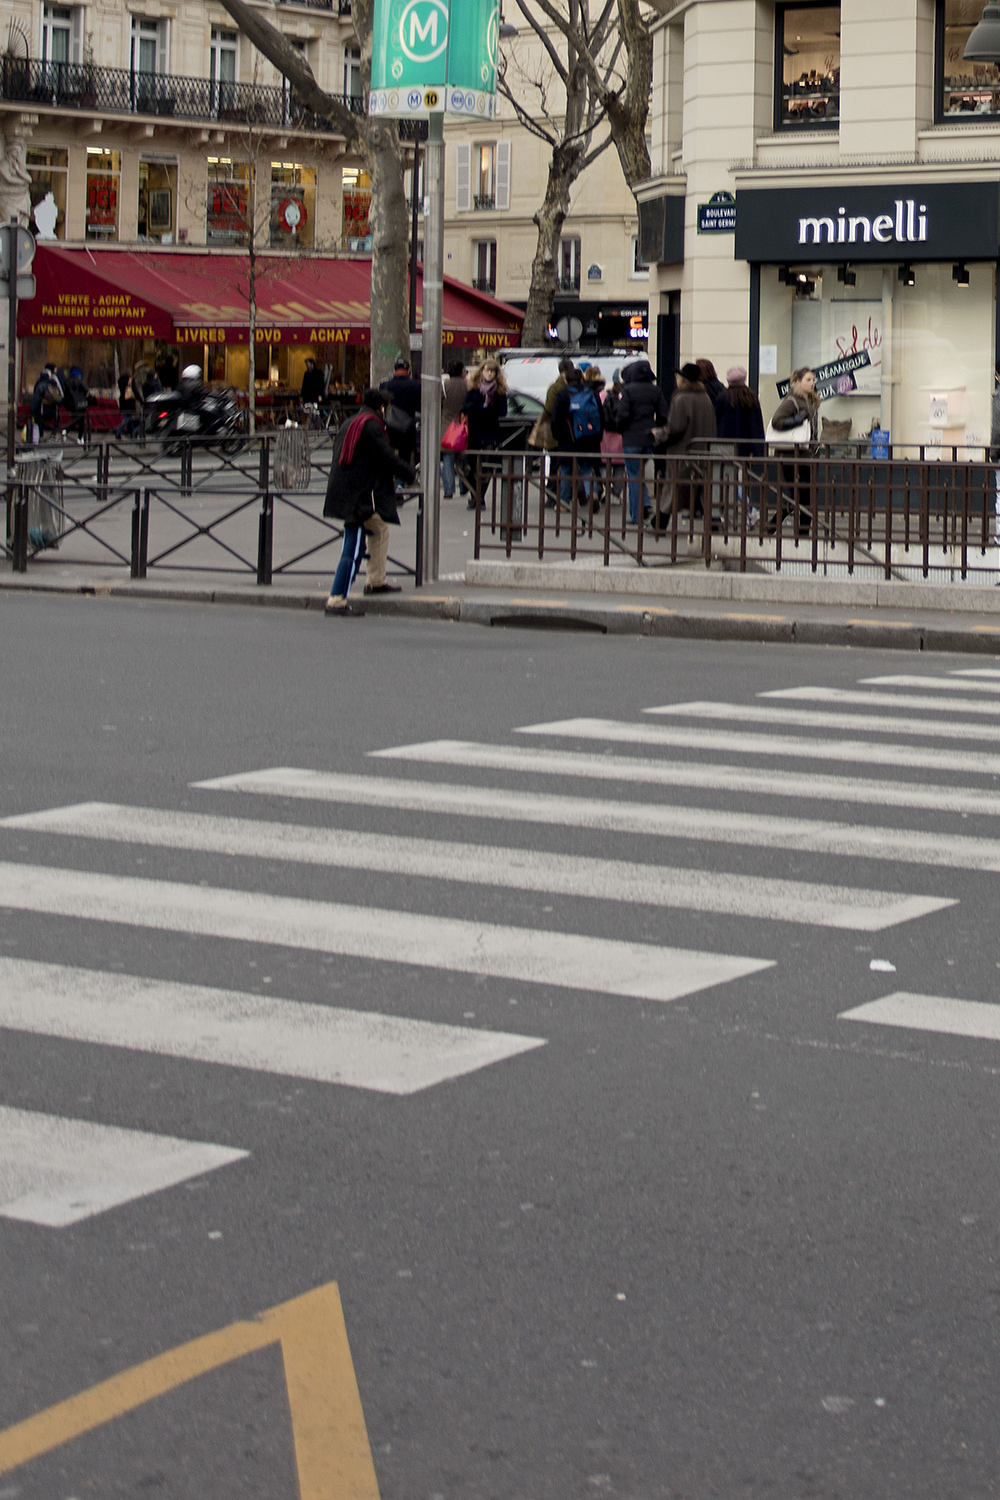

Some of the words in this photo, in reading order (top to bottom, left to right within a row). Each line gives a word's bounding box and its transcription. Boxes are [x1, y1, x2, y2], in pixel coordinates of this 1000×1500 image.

[409, 9, 438, 48] M
[426, 94, 438, 106] 10
[88, 188, 117, 208] ICI
[701, 219, 717, 228] SAINT
[798, 200, 927, 243] minelli
[58, 294, 90, 305] VENTE
[98, 294, 131, 305] ACHAT
[42, 305, 90, 317] PAIEMENT
[93, 306, 147, 318] COMPTANT
[31, 324, 65, 335] LIVRES
[74, 324, 93, 335] DVD
[103, 325, 116, 335] CD
[125, 325, 155, 336] VINYL
[176, 328, 226, 342] LIVRES
[256, 329, 281, 342] DVD
[310, 329, 350, 342] ACHAT
[478, 333, 511, 347] VINYL
